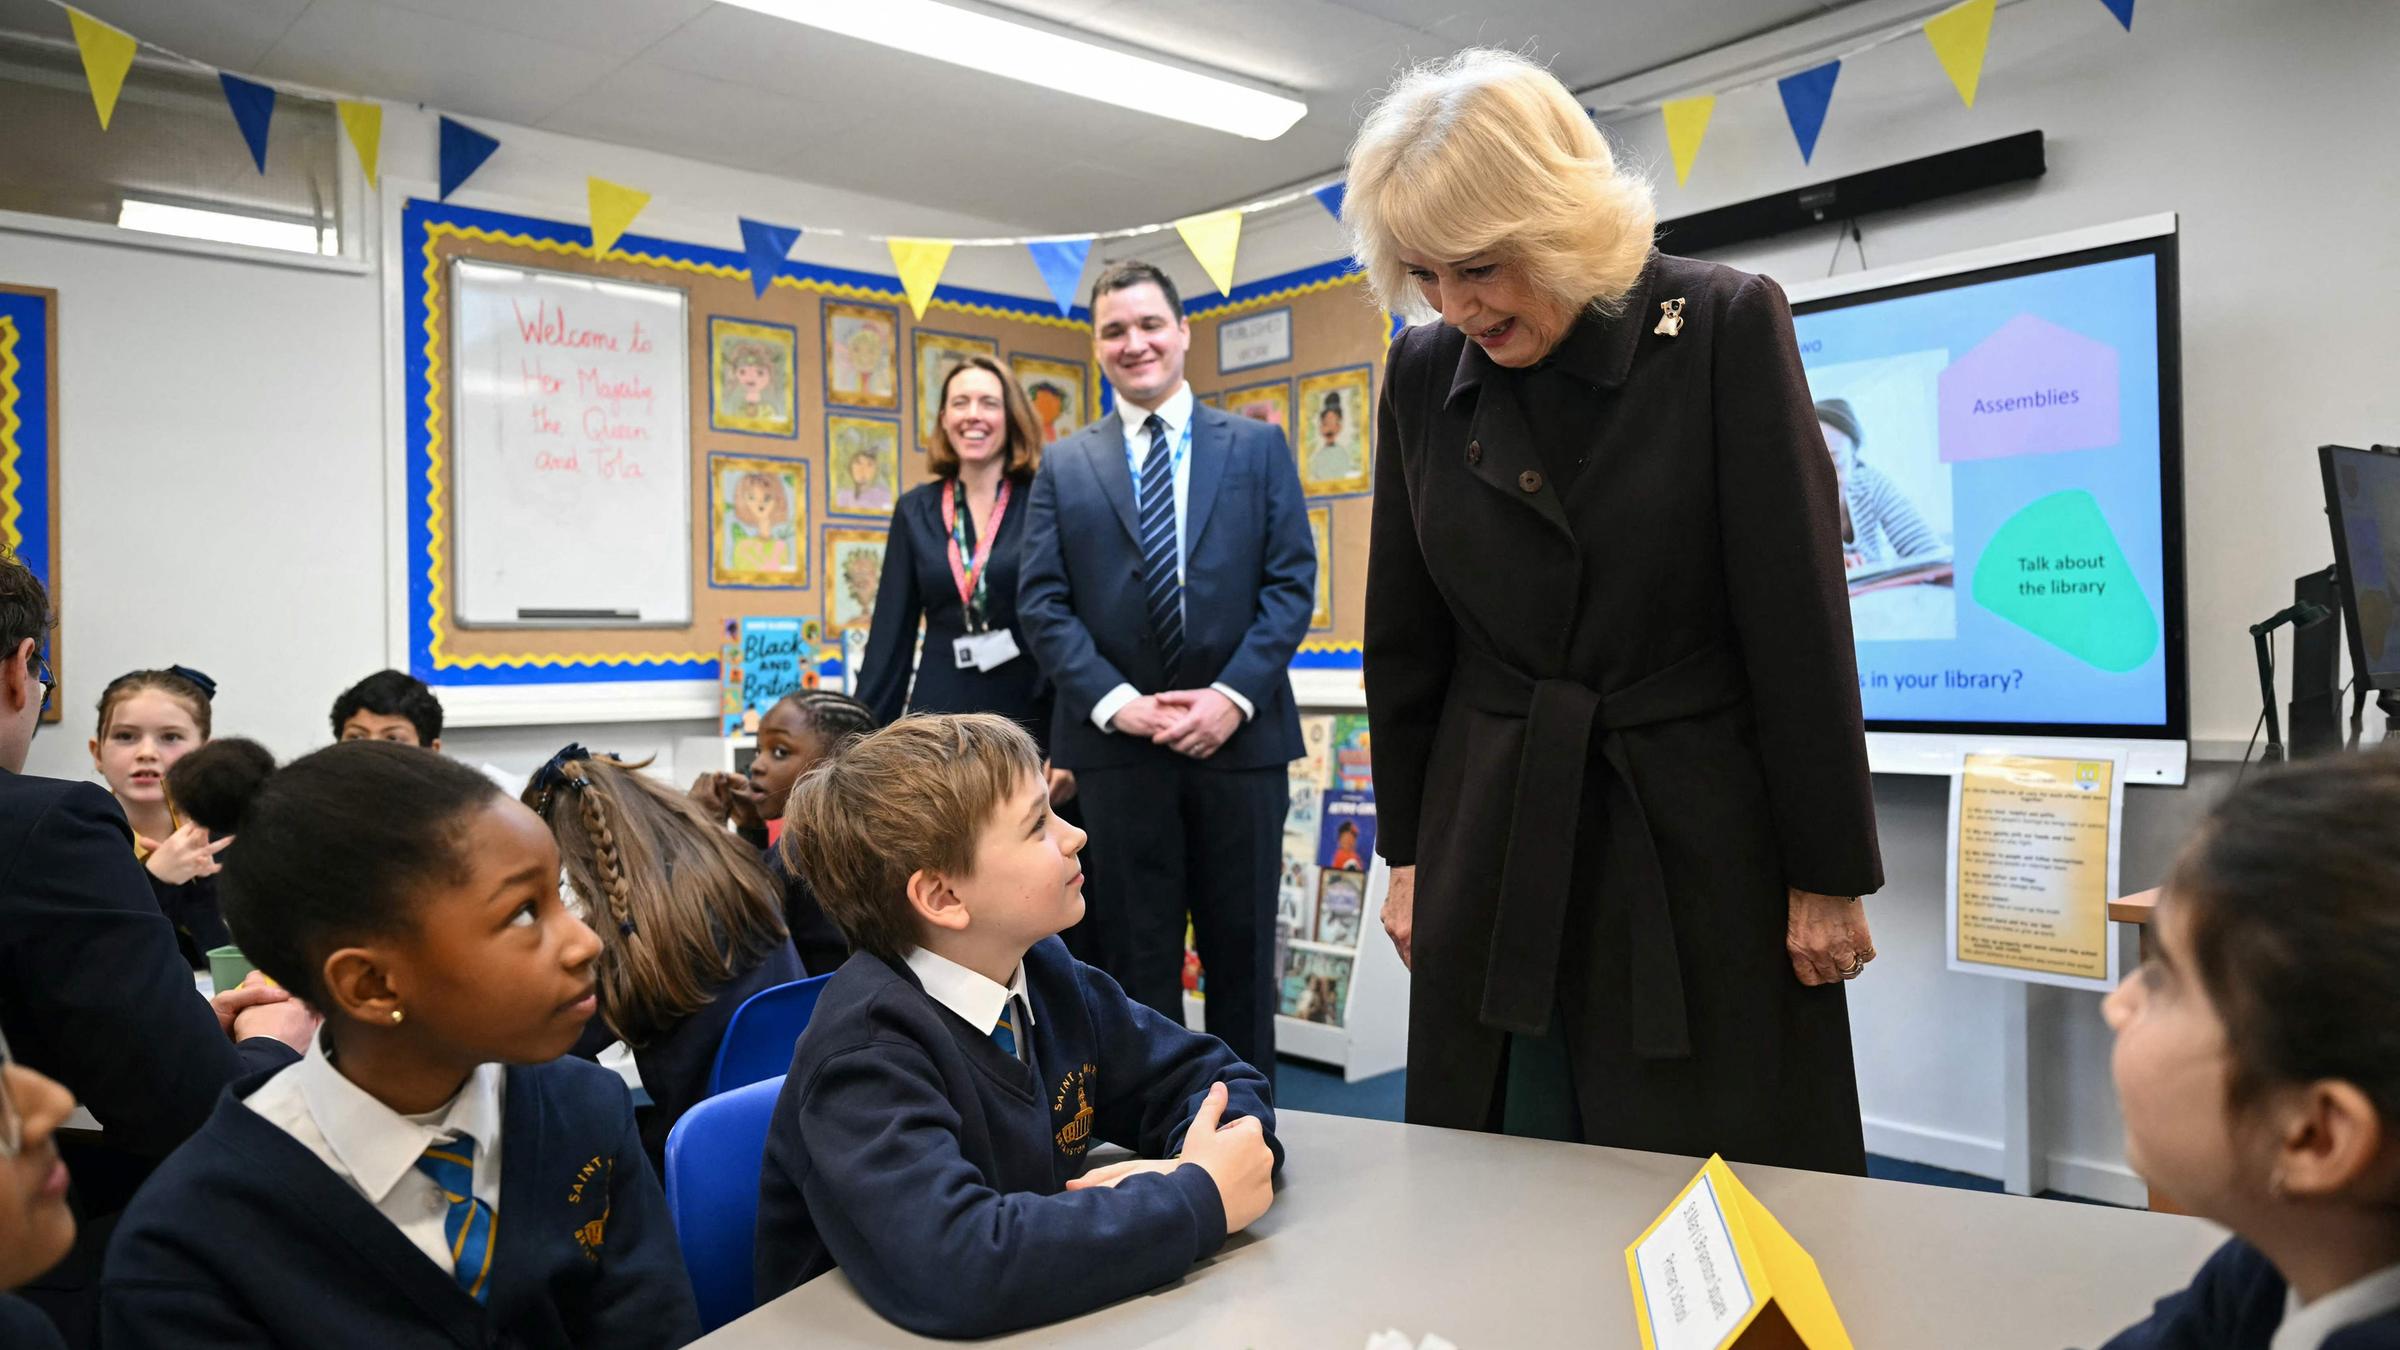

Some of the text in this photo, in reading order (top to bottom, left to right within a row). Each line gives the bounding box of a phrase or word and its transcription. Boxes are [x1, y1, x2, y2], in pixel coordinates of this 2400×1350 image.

[512, 296, 653, 353] Welcome to
[1801, 339, 1822, 352] wo
[521, 354, 655, 418] Her Majesty
[1973, 388, 2080, 415] Assemblies
[531, 402, 649, 442] the Queen
[535, 446, 644, 479] and Tola
[2018, 554, 2106, 572] Talk about
[2018, 579, 2107, 597] the library
[744, 631, 803, 664] Black
[758, 660, 792, 672] AND
[1871, 670, 1888, 688] in
[1893, 673, 1939, 692] your
[1944, 669, 2023, 693] library?
[1054, 1071, 1075, 1112] SAINT
[568, 1156, 602, 1203] SAINT
